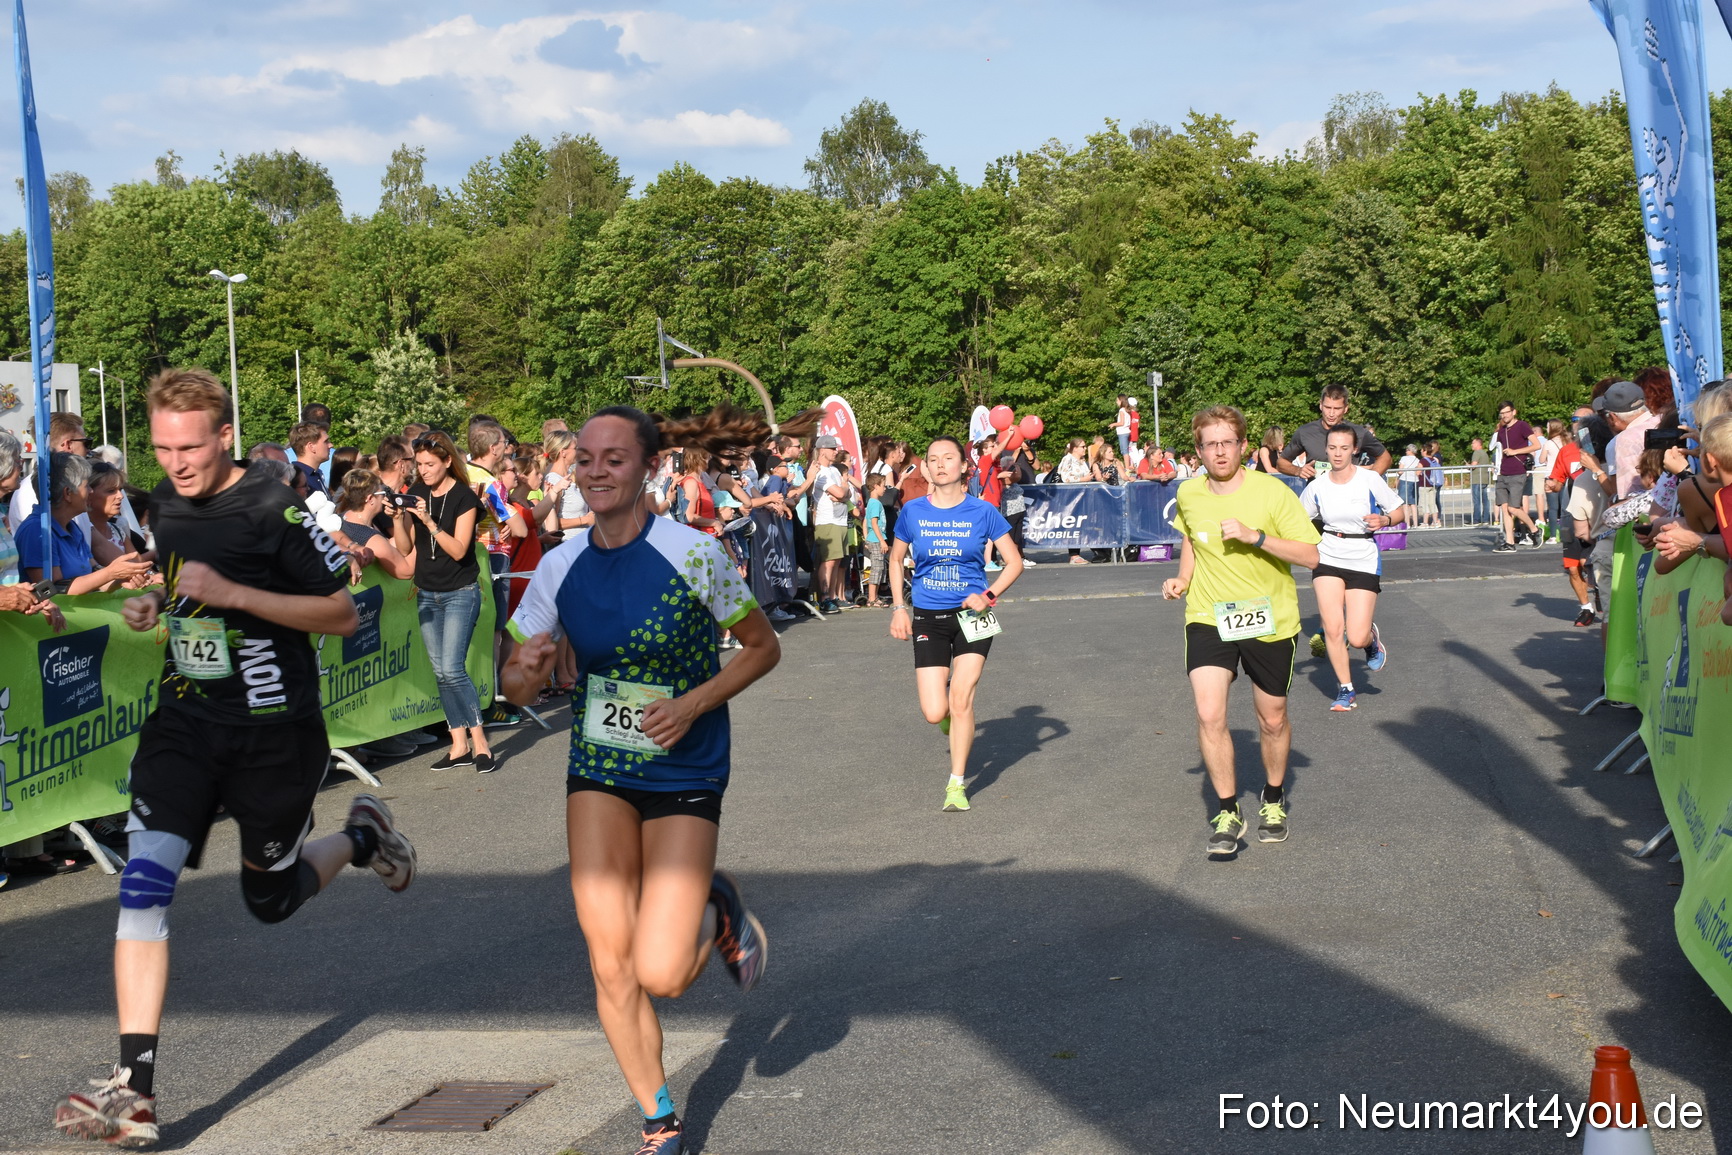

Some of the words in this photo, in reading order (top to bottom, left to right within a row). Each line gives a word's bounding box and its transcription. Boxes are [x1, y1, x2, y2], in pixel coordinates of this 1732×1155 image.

[918, 519, 941, 528] Wenn
[952, 520, 972, 528] beim
[1023, 511, 1088, 529] scher
[920, 529, 971, 538] Hausverkauf
[932, 538, 958, 548] richtig
[1022, 530, 1080, 539] TOMOBILE
[928, 548, 962, 557] LAUFEN
[970, 612, 997, 631] 730
[1223, 610, 1267, 630] 1225
[173, 638, 219, 662] 1742
[52, 654, 94, 680] Fischer
[328, 630, 412, 704] firmenlauf
[58, 669, 90, 687] AUTOMOBILE
[330, 692, 368, 722] neumarkt
[17, 678, 155, 780] firmenlauf
[20, 760, 83, 802] neumarkt
